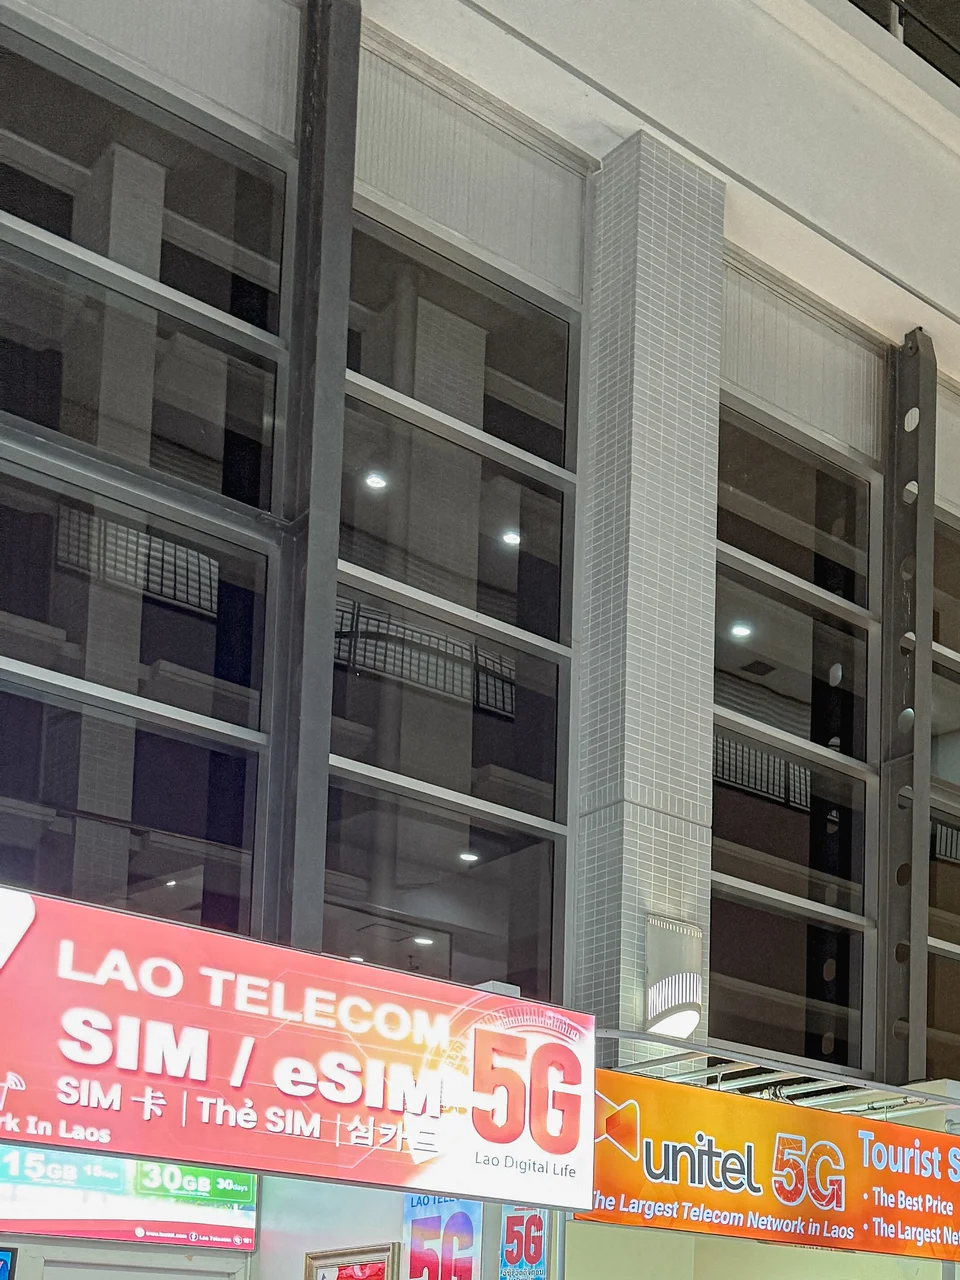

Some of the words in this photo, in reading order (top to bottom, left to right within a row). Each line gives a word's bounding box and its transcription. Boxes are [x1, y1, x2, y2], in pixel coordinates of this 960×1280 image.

[57, 939, 184, 998] LAO
[200, 967, 451, 1048] TELECOM
[58, 1007, 209, 1081] SIM
[230, 1037, 254, 1088] /
[272, 1048, 443, 1118] eSIM
[57, 1076, 121, 1110] SIM
[131, 1086, 167, 1120] 卡
[472, 1027, 582, 1155] 5G
[26, 1115, 52, 1136] In
[59, 1119, 111, 1143] Laos
[196, 1096, 258, 1129] Thẻ
[265, 1106, 321, 1138] SIM
[347, 1114, 438, 1153] 심카드
[3, 1150, 77, 1180] 15GB
[475, 1152, 500, 1167] Lao
[504, 1155, 549, 1176] Digital
[553, 1164, 576, 1178] Life
[643, 1131, 763, 1196] unitel
[772, 1132, 845, 1212] 5G
[858, 1130, 941, 1179] Tourist
[142, 1163, 211, 1192] 30GB
[411, 1195, 429, 1207] LAO
[593, 1190, 616, 1210] he
[619, 1194, 678, 1218] Largest
[682, 1203, 743, 1227] Telecom
[747, 1212, 804, 1234] Network
[807, 1218, 820, 1235] in
[823, 1220, 854, 1240] Laos
[872, 1187, 895, 1208] The
[897, 1190, 923, 1212] Best
[925, 1194, 953, 1215] Price
[505, 1214, 543, 1265] 5G
[872, 1217, 895, 1238] The
[898, 1220, 941, 1246] Largest
